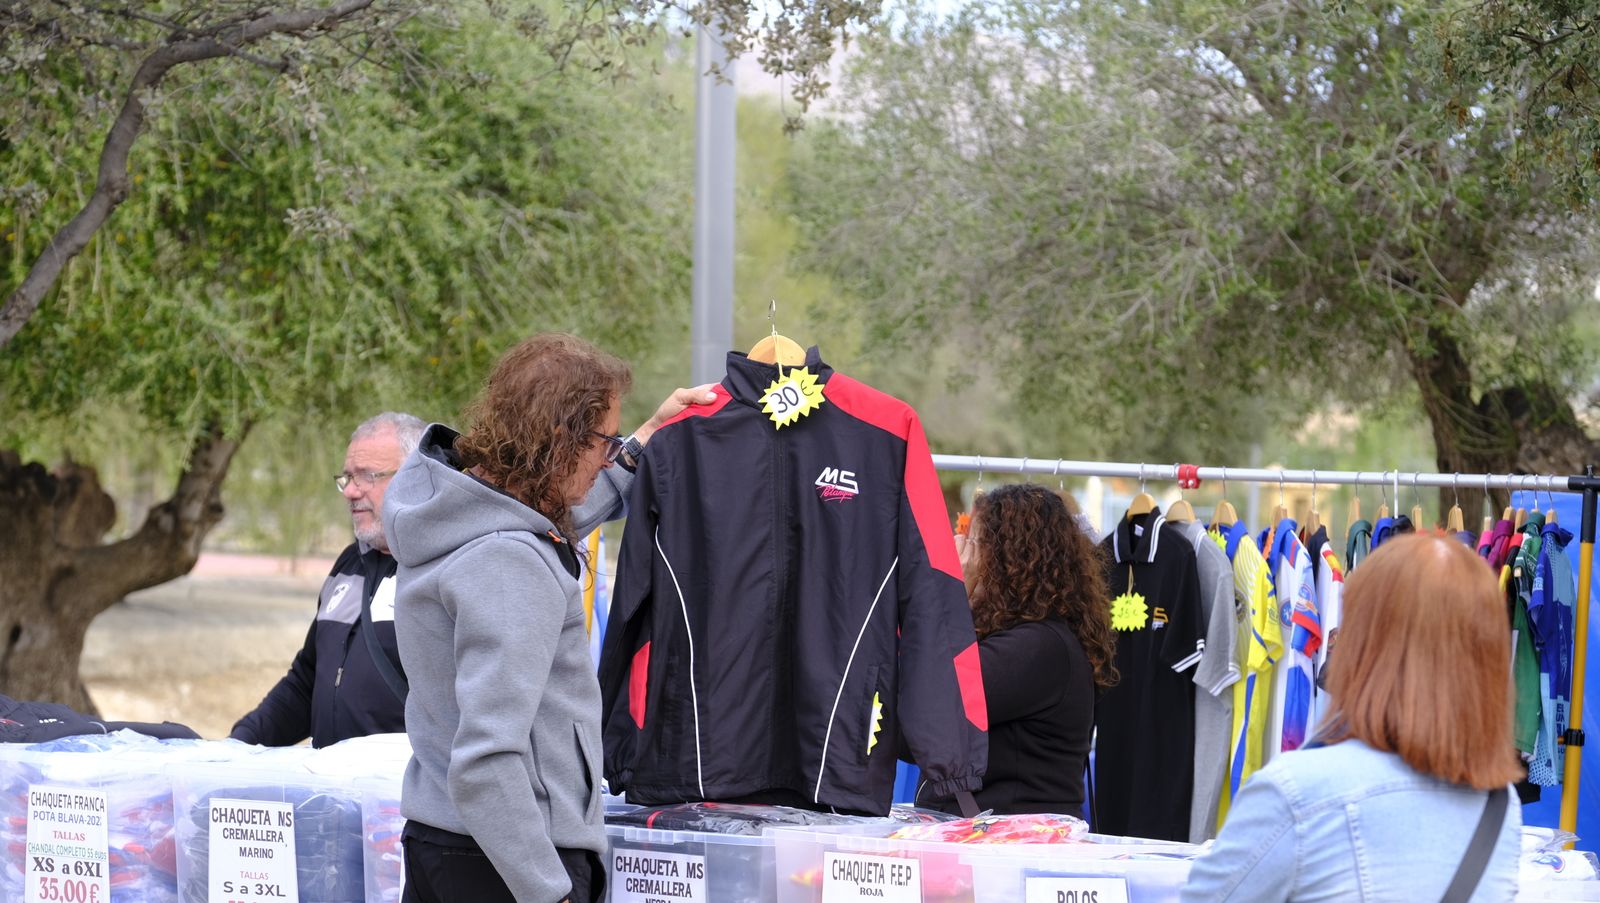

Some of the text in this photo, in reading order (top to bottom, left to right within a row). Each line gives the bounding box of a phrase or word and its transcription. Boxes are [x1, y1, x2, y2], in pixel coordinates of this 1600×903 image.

[814, 466, 860, 495] MS
[31, 791, 105, 813] CHAQUETA FRANCA
[33, 810, 103, 826] POTA BLAVA-202
[212, 807, 292, 828] CHAQUETA NS
[53, 830, 86, 841] TALLAS
[222, 827, 284, 843] CREMALLERA
[28, 842, 55, 854] CHANDAL
[56, 844, 86, 858] COMPLETO
[239, 846, 274, 859] MARINO
[32, 856, 103, 878] XS a 6XL
[615, 855, 704, 880] CHAQUETA MS
[832, 858, 885, 886] CHAQUETA
[240, 871, 269, 880] TALLAS
[223, 881, 286, 897] S a 3XL
[625, 877, 692, 898] CREMALLERA
[859, 887, 884, 897] ROJA
